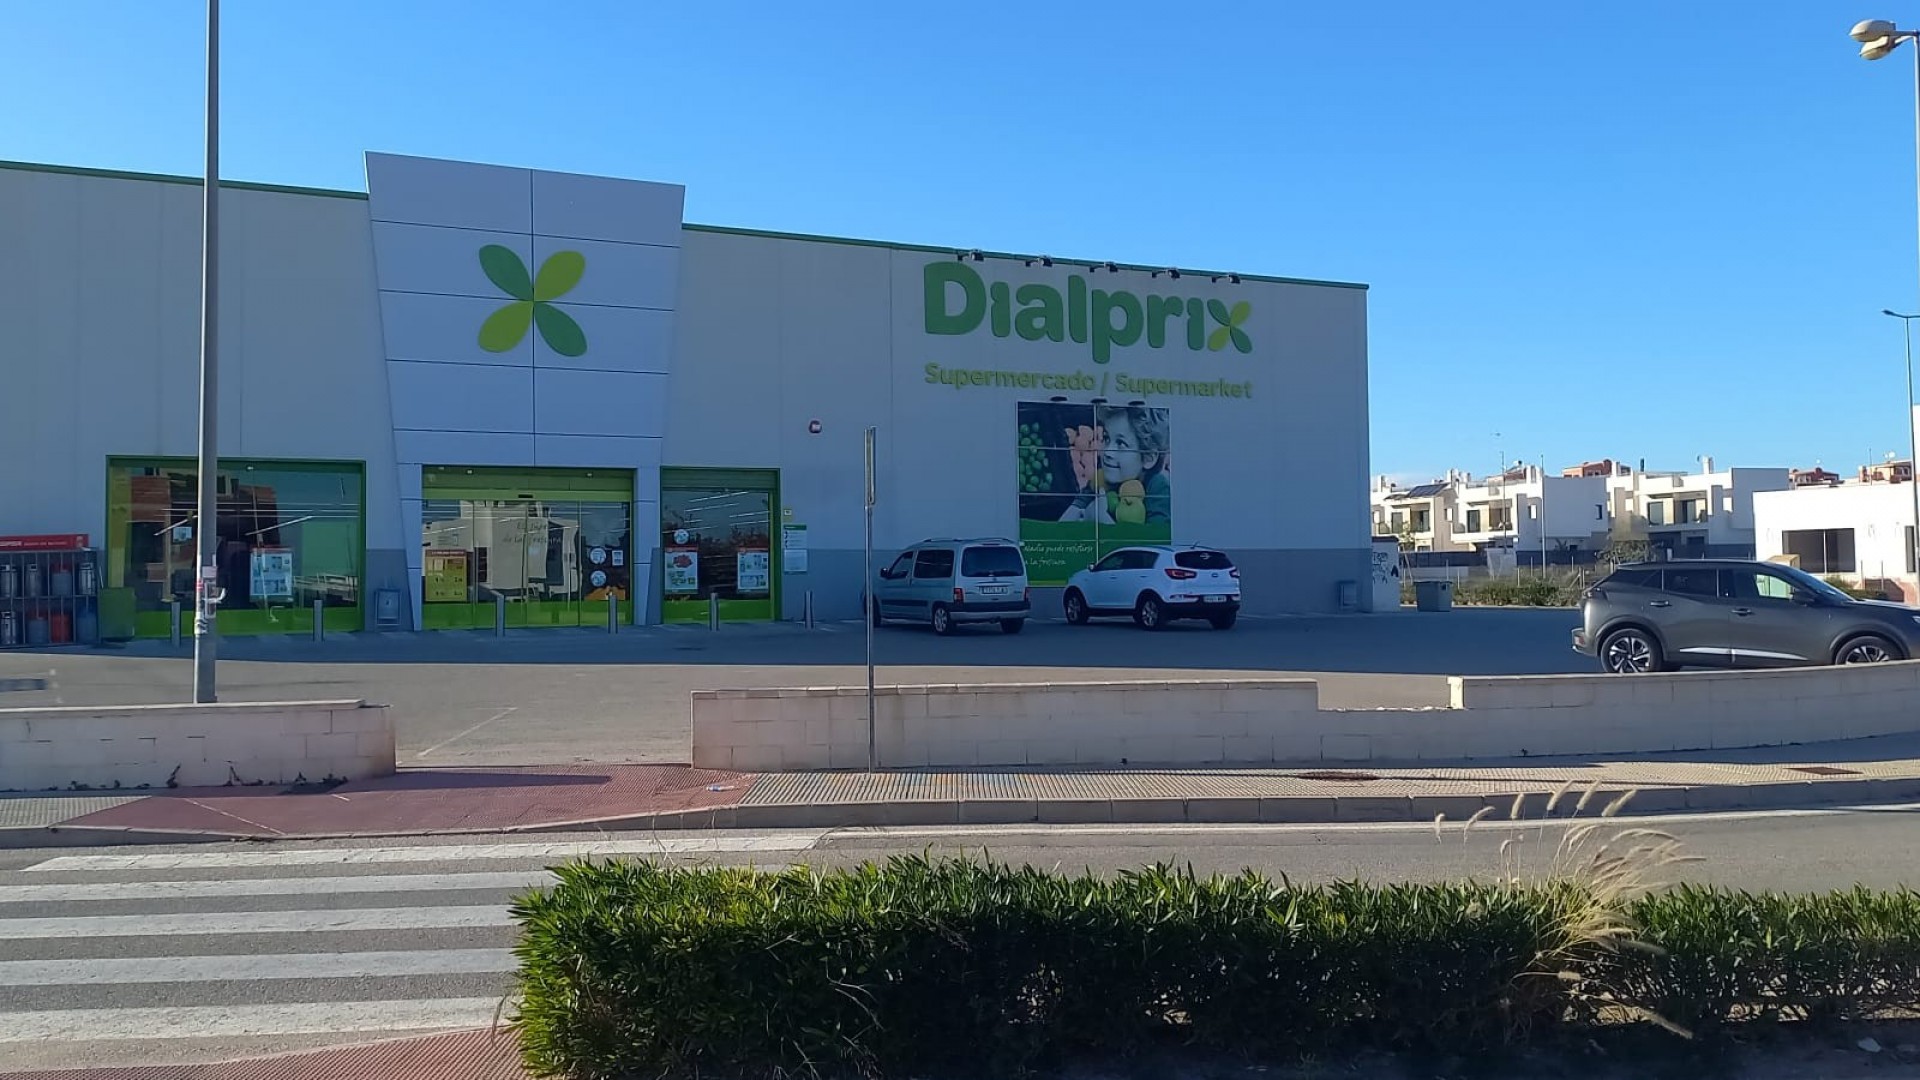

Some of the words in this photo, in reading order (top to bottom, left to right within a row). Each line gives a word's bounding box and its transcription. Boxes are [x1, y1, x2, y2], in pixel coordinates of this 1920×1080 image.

[924, 261, 1252, 364] Dialprix
[924, 362, 1096, 389] Supermercado
[1099, 371, 1109, 396] /
[1115, 373, 1253, 399] Supermarket
